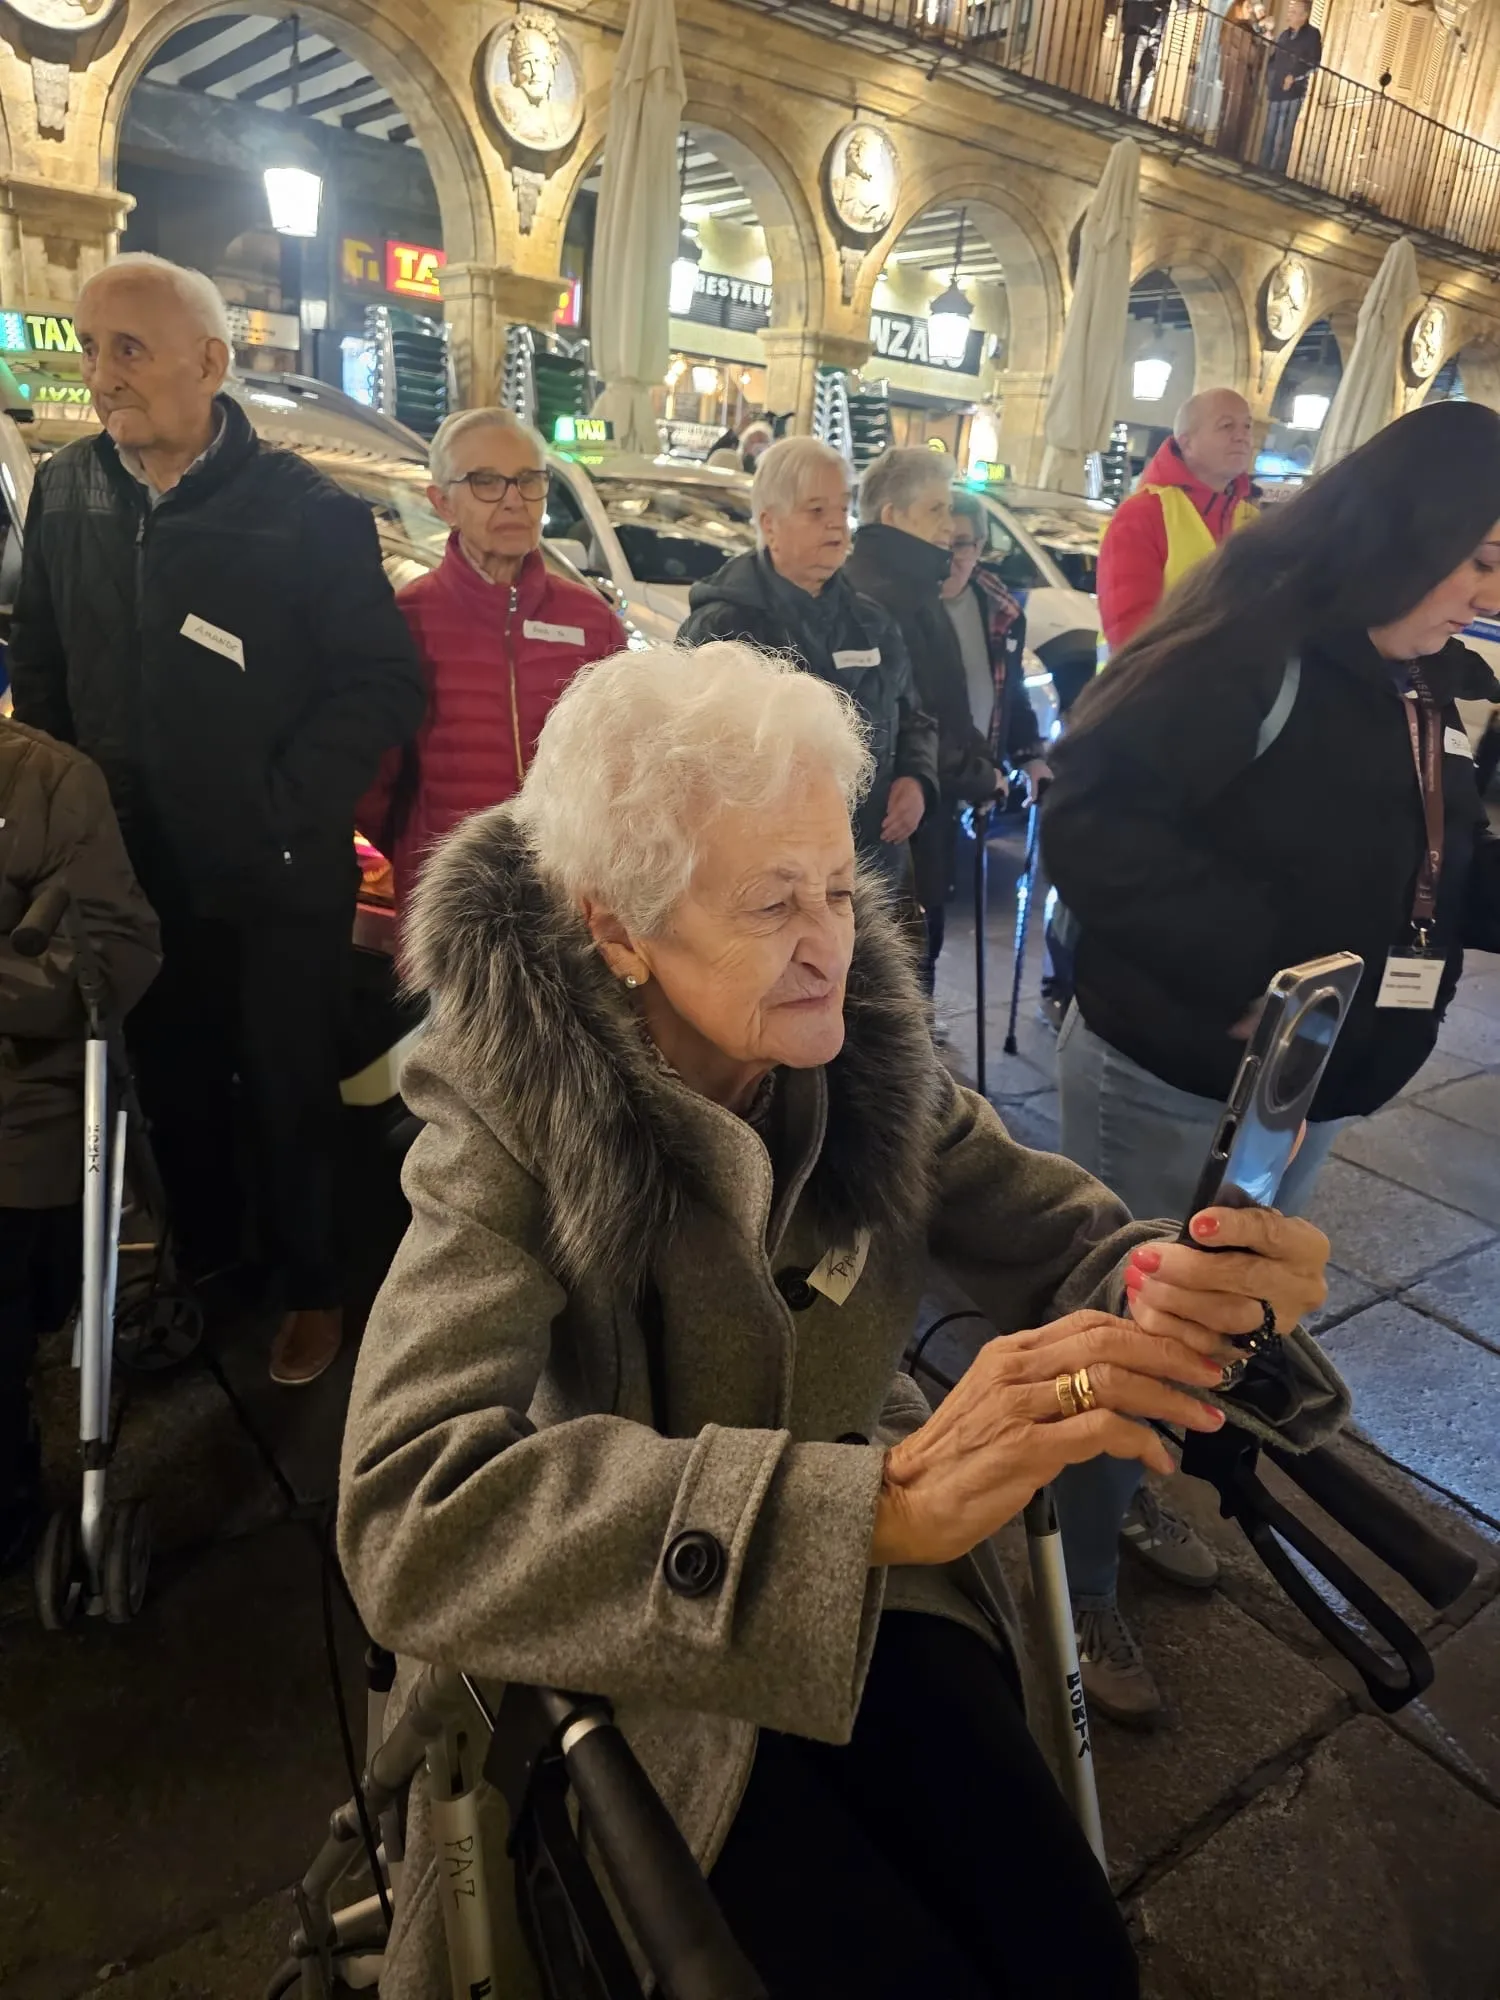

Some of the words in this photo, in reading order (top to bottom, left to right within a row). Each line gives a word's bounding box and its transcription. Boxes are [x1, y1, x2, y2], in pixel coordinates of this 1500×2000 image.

[870, 315, 966, 368] NZA
[575, 418, 606, 440] TAXI
[444, 1836, 476, 1910] PAZ
